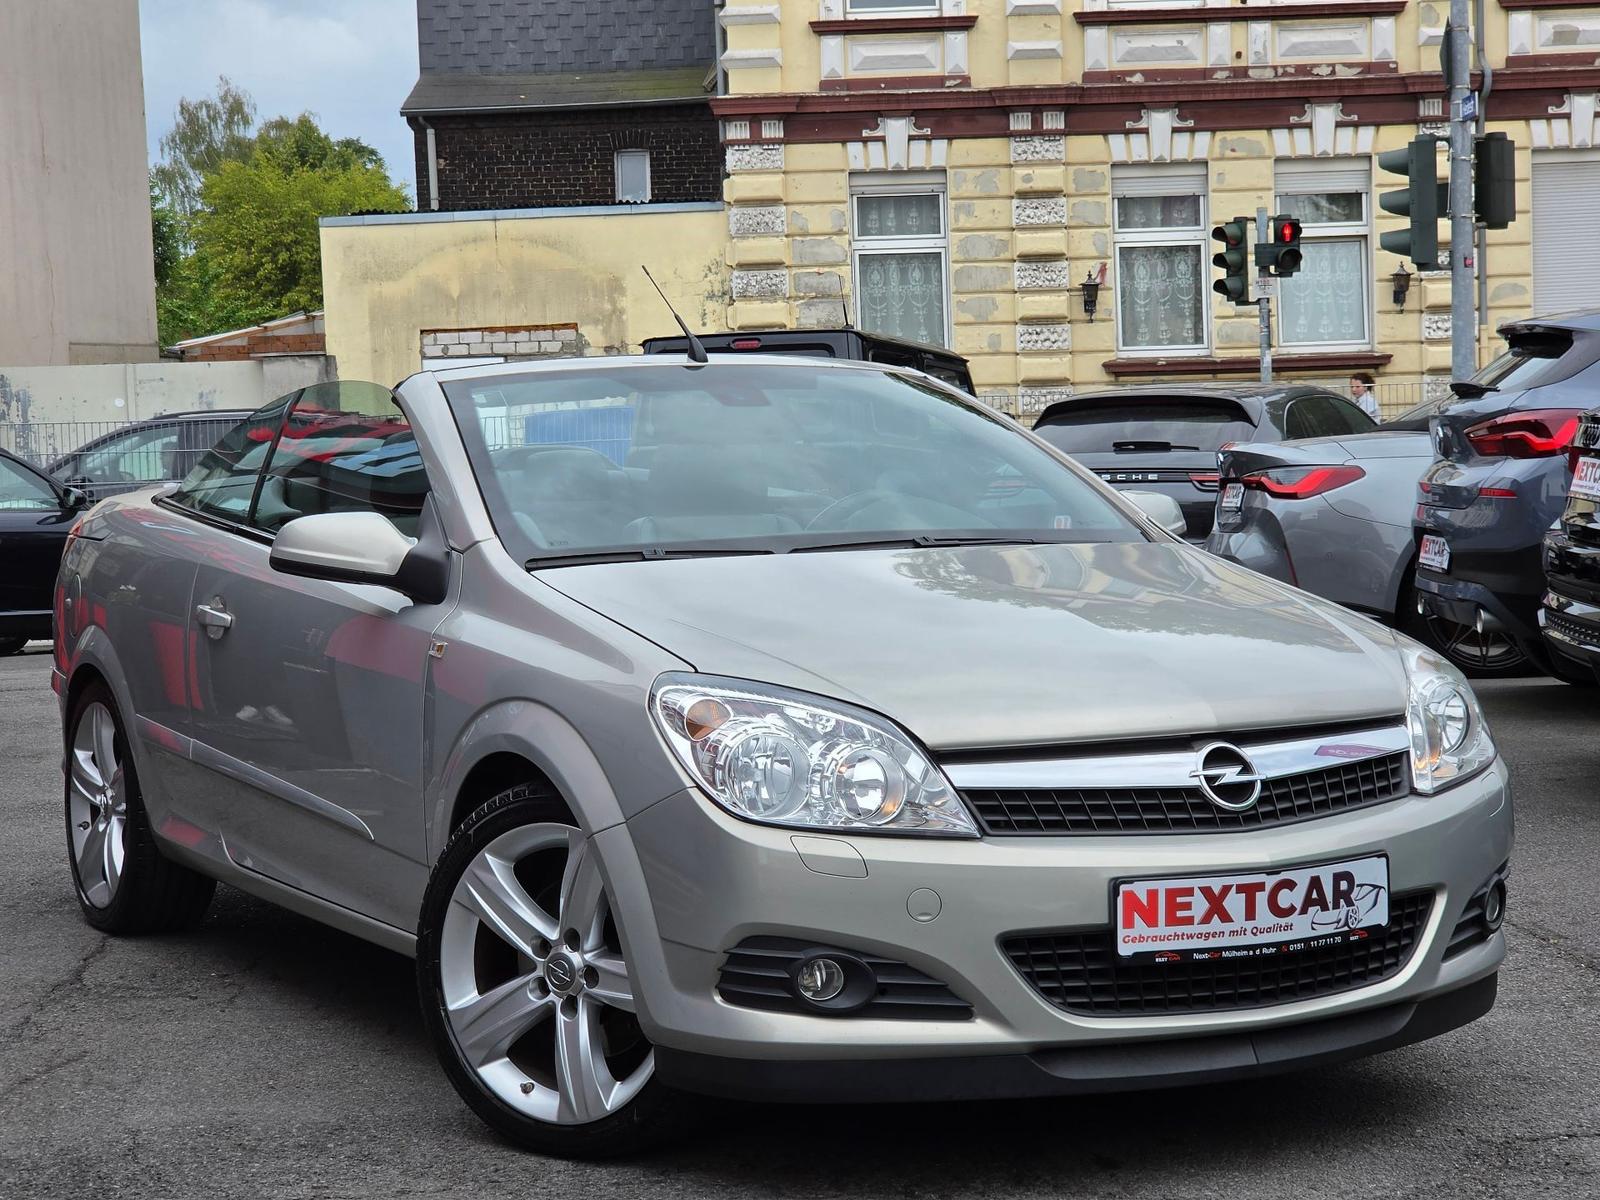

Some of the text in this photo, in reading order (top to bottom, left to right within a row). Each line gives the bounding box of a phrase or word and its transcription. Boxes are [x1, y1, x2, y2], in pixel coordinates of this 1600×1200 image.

[1122, 870, 1355, 930] NEXTCAR
[1122, 922, 1293, 944] Gebrauchtwagen mit Qualität
[1222, 949, 1248, 957] Mülheim
[1289, 943, 1304, 951] 0151
